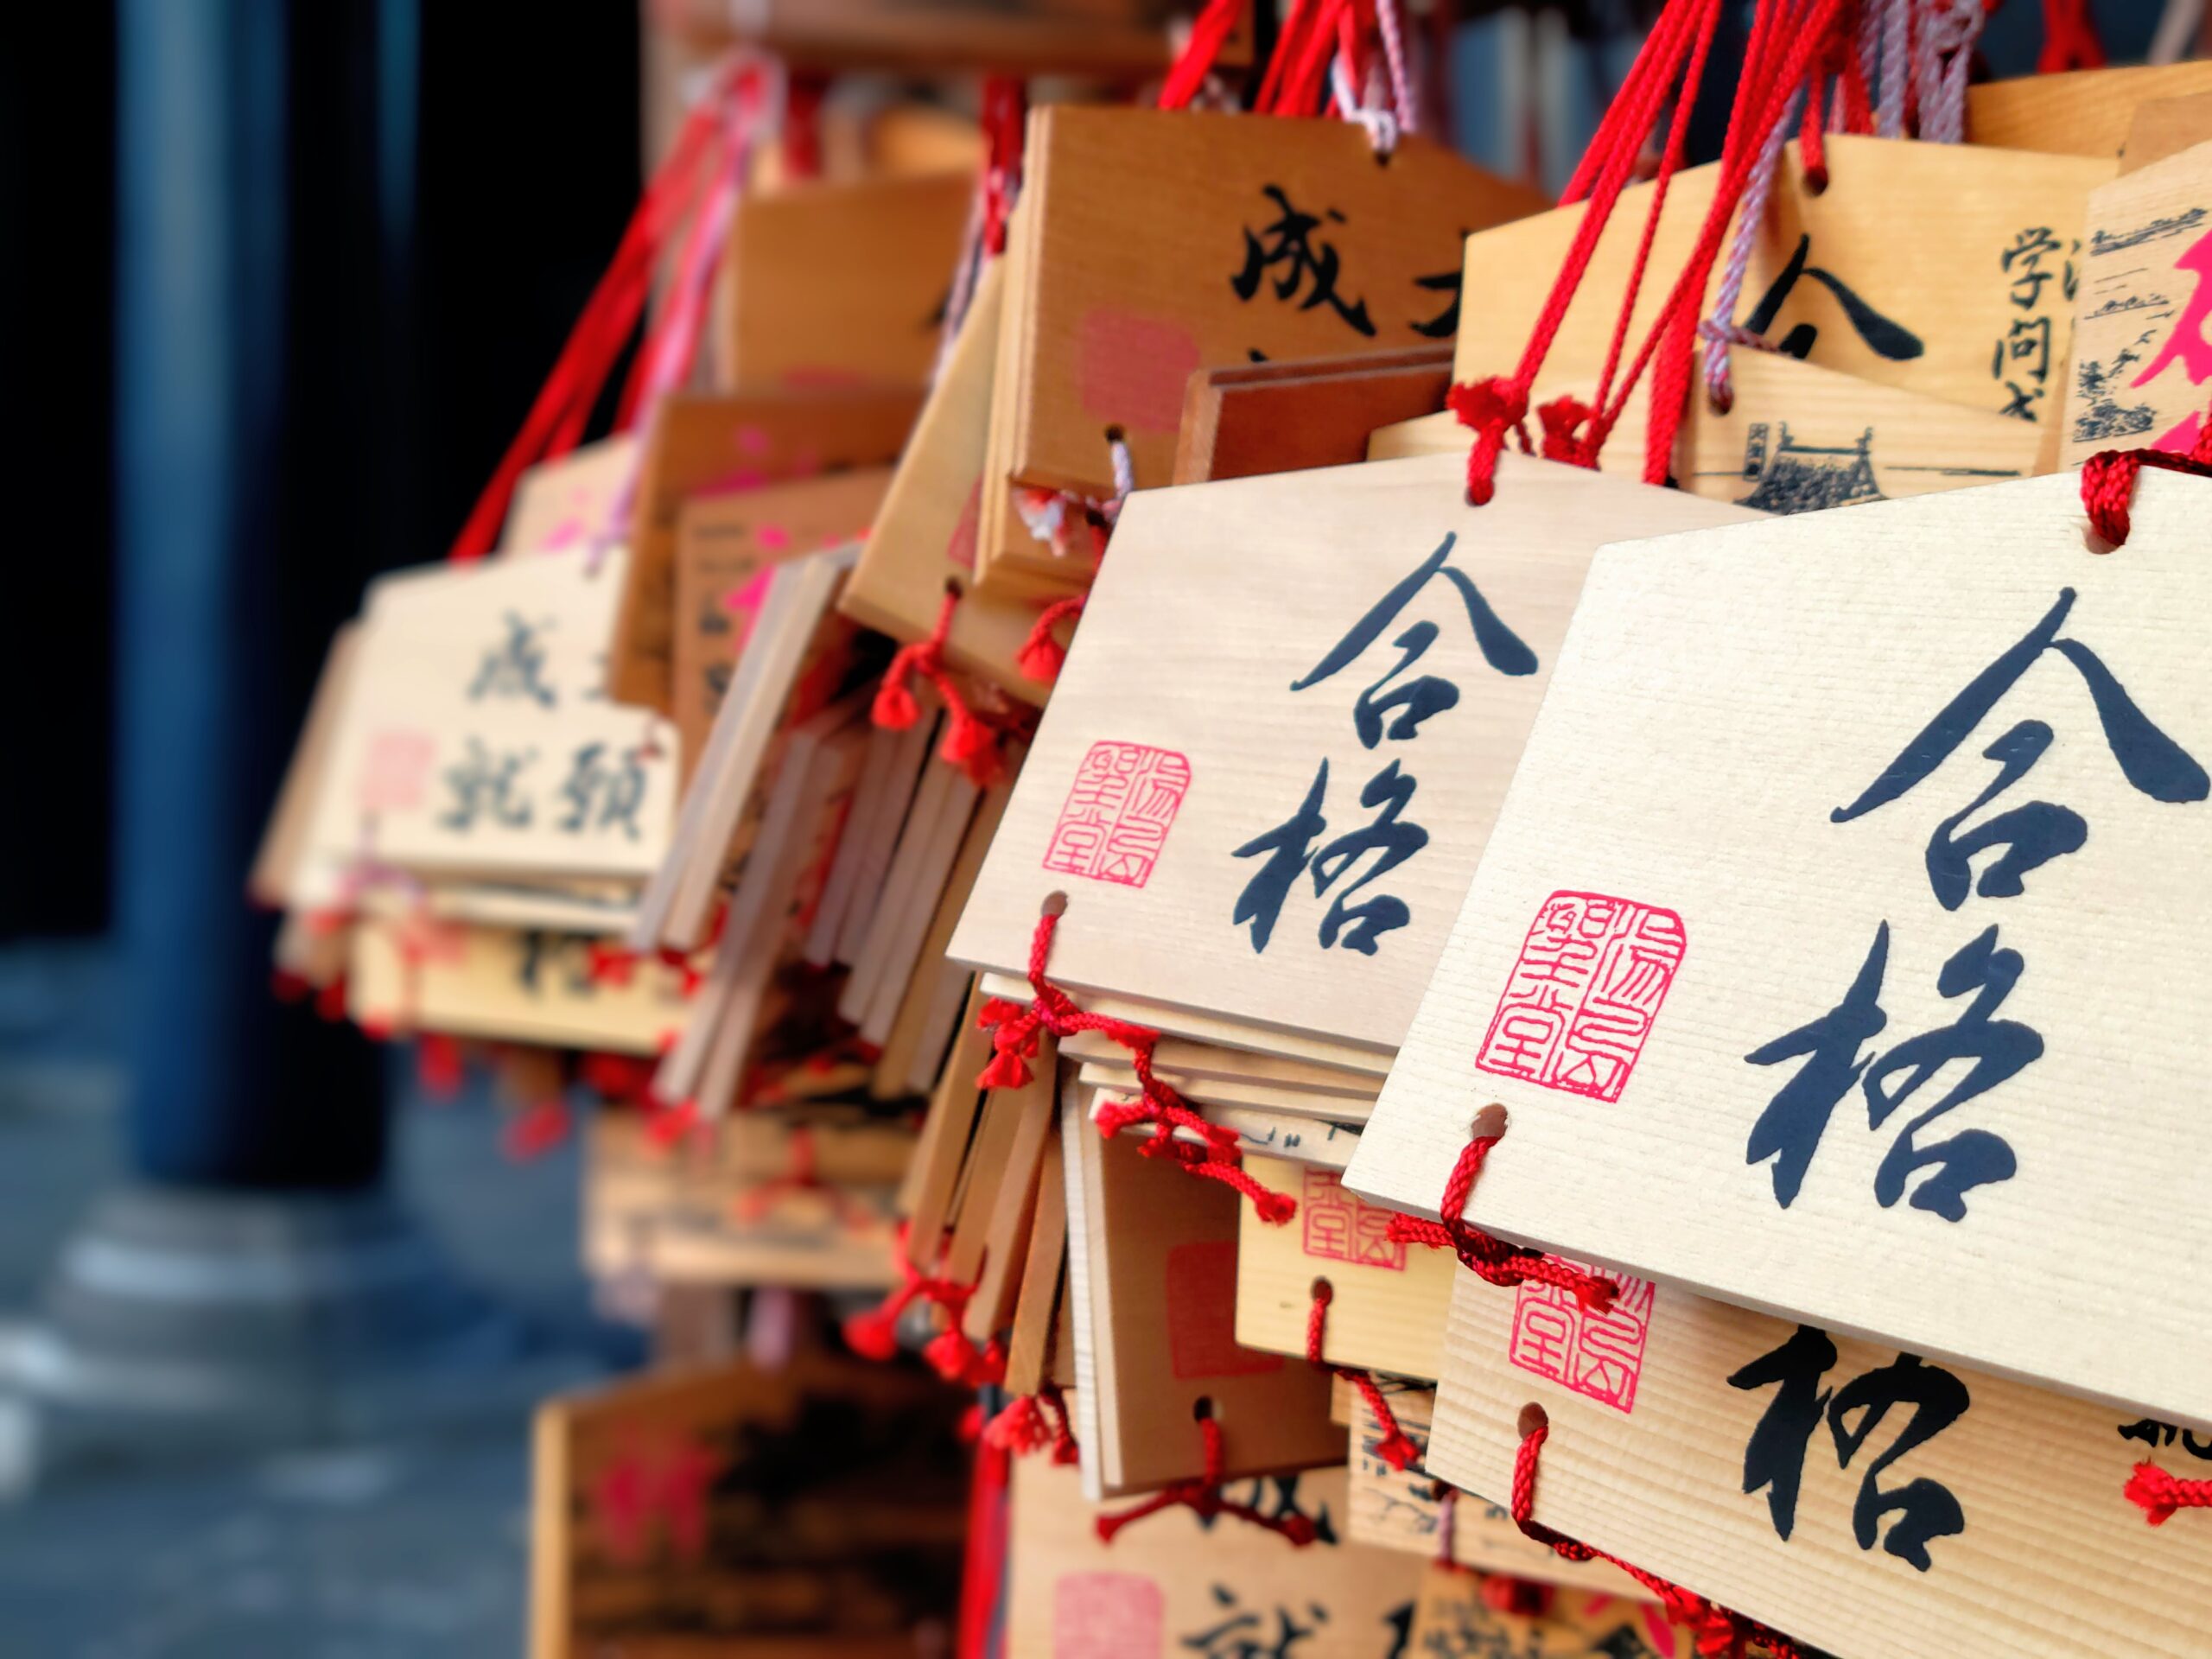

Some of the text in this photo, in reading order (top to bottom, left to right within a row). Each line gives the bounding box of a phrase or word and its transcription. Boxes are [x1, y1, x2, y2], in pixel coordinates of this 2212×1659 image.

[1230, 185, 1376, 363] 成
[1230, 531, 1538, 956] 合格
[1744, 586, 2211, 1223] 合格
[1727, 1325, 1970, 1573] 格
